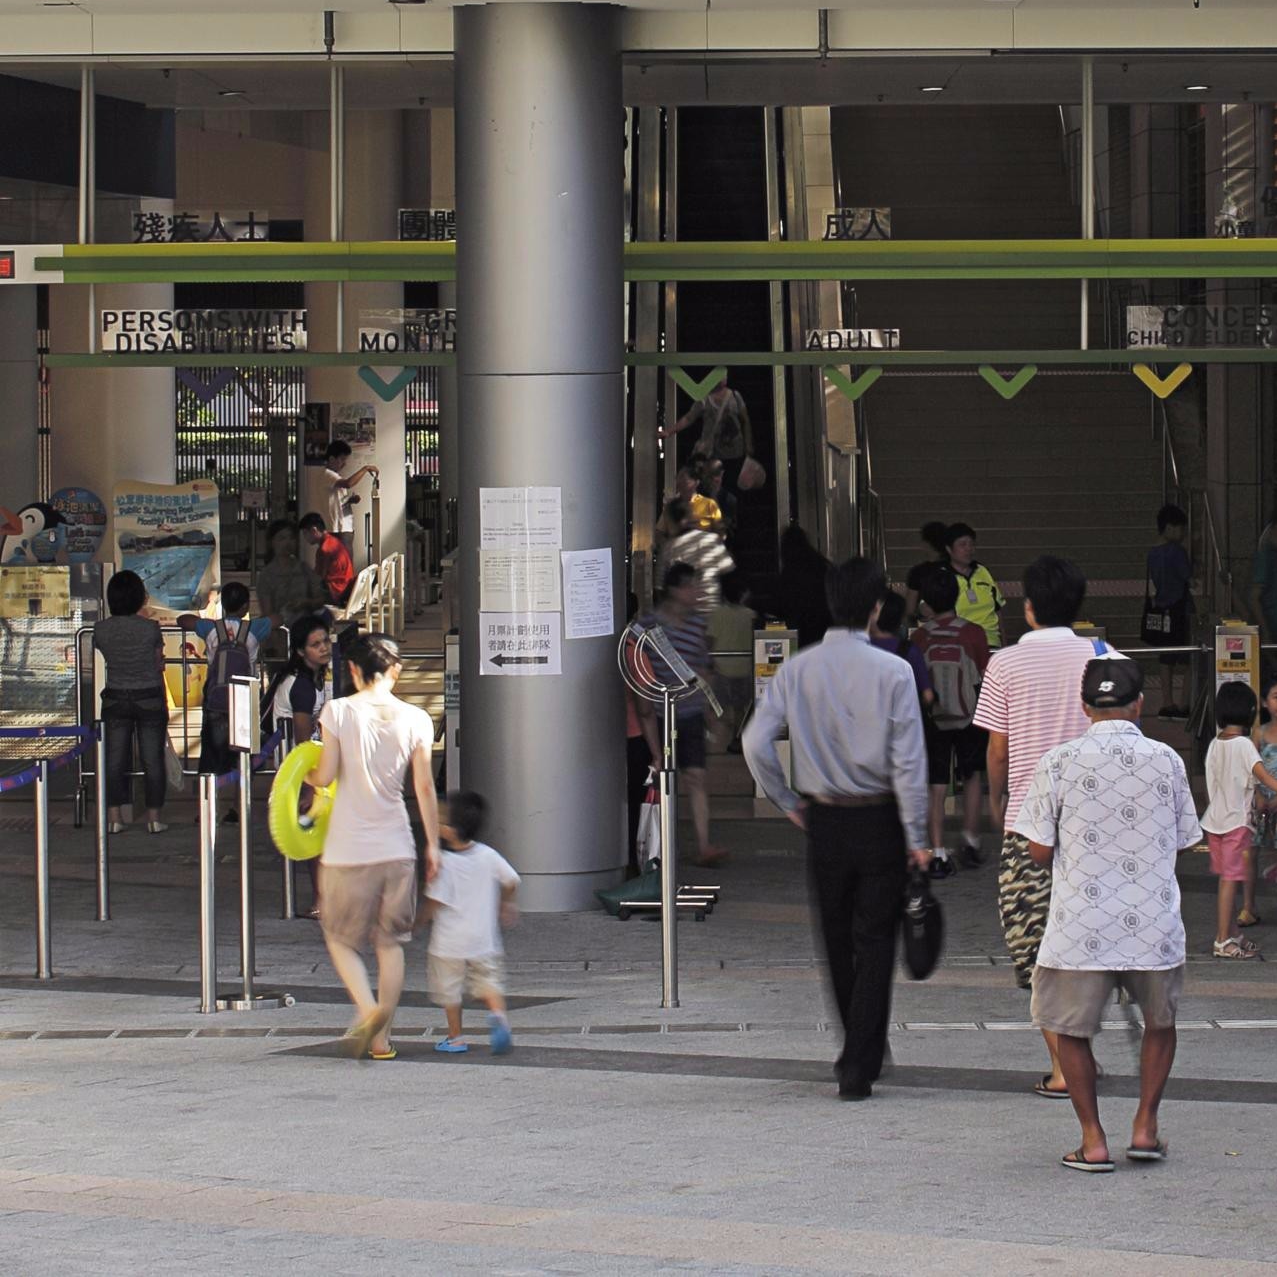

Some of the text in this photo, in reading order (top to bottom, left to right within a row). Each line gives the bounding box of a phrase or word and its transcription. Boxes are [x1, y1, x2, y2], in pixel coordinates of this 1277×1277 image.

[133, 211, 268, 243] 殘疾人士
[822, 208, 890, 241] 成人
[103, 310, 307, 332] PERSONS WITH
[115, 332, 297, 354] DISABILITIES
[808, 330, 898, 351] ADULT
[1127, 329, 1185, 345] CHILD
